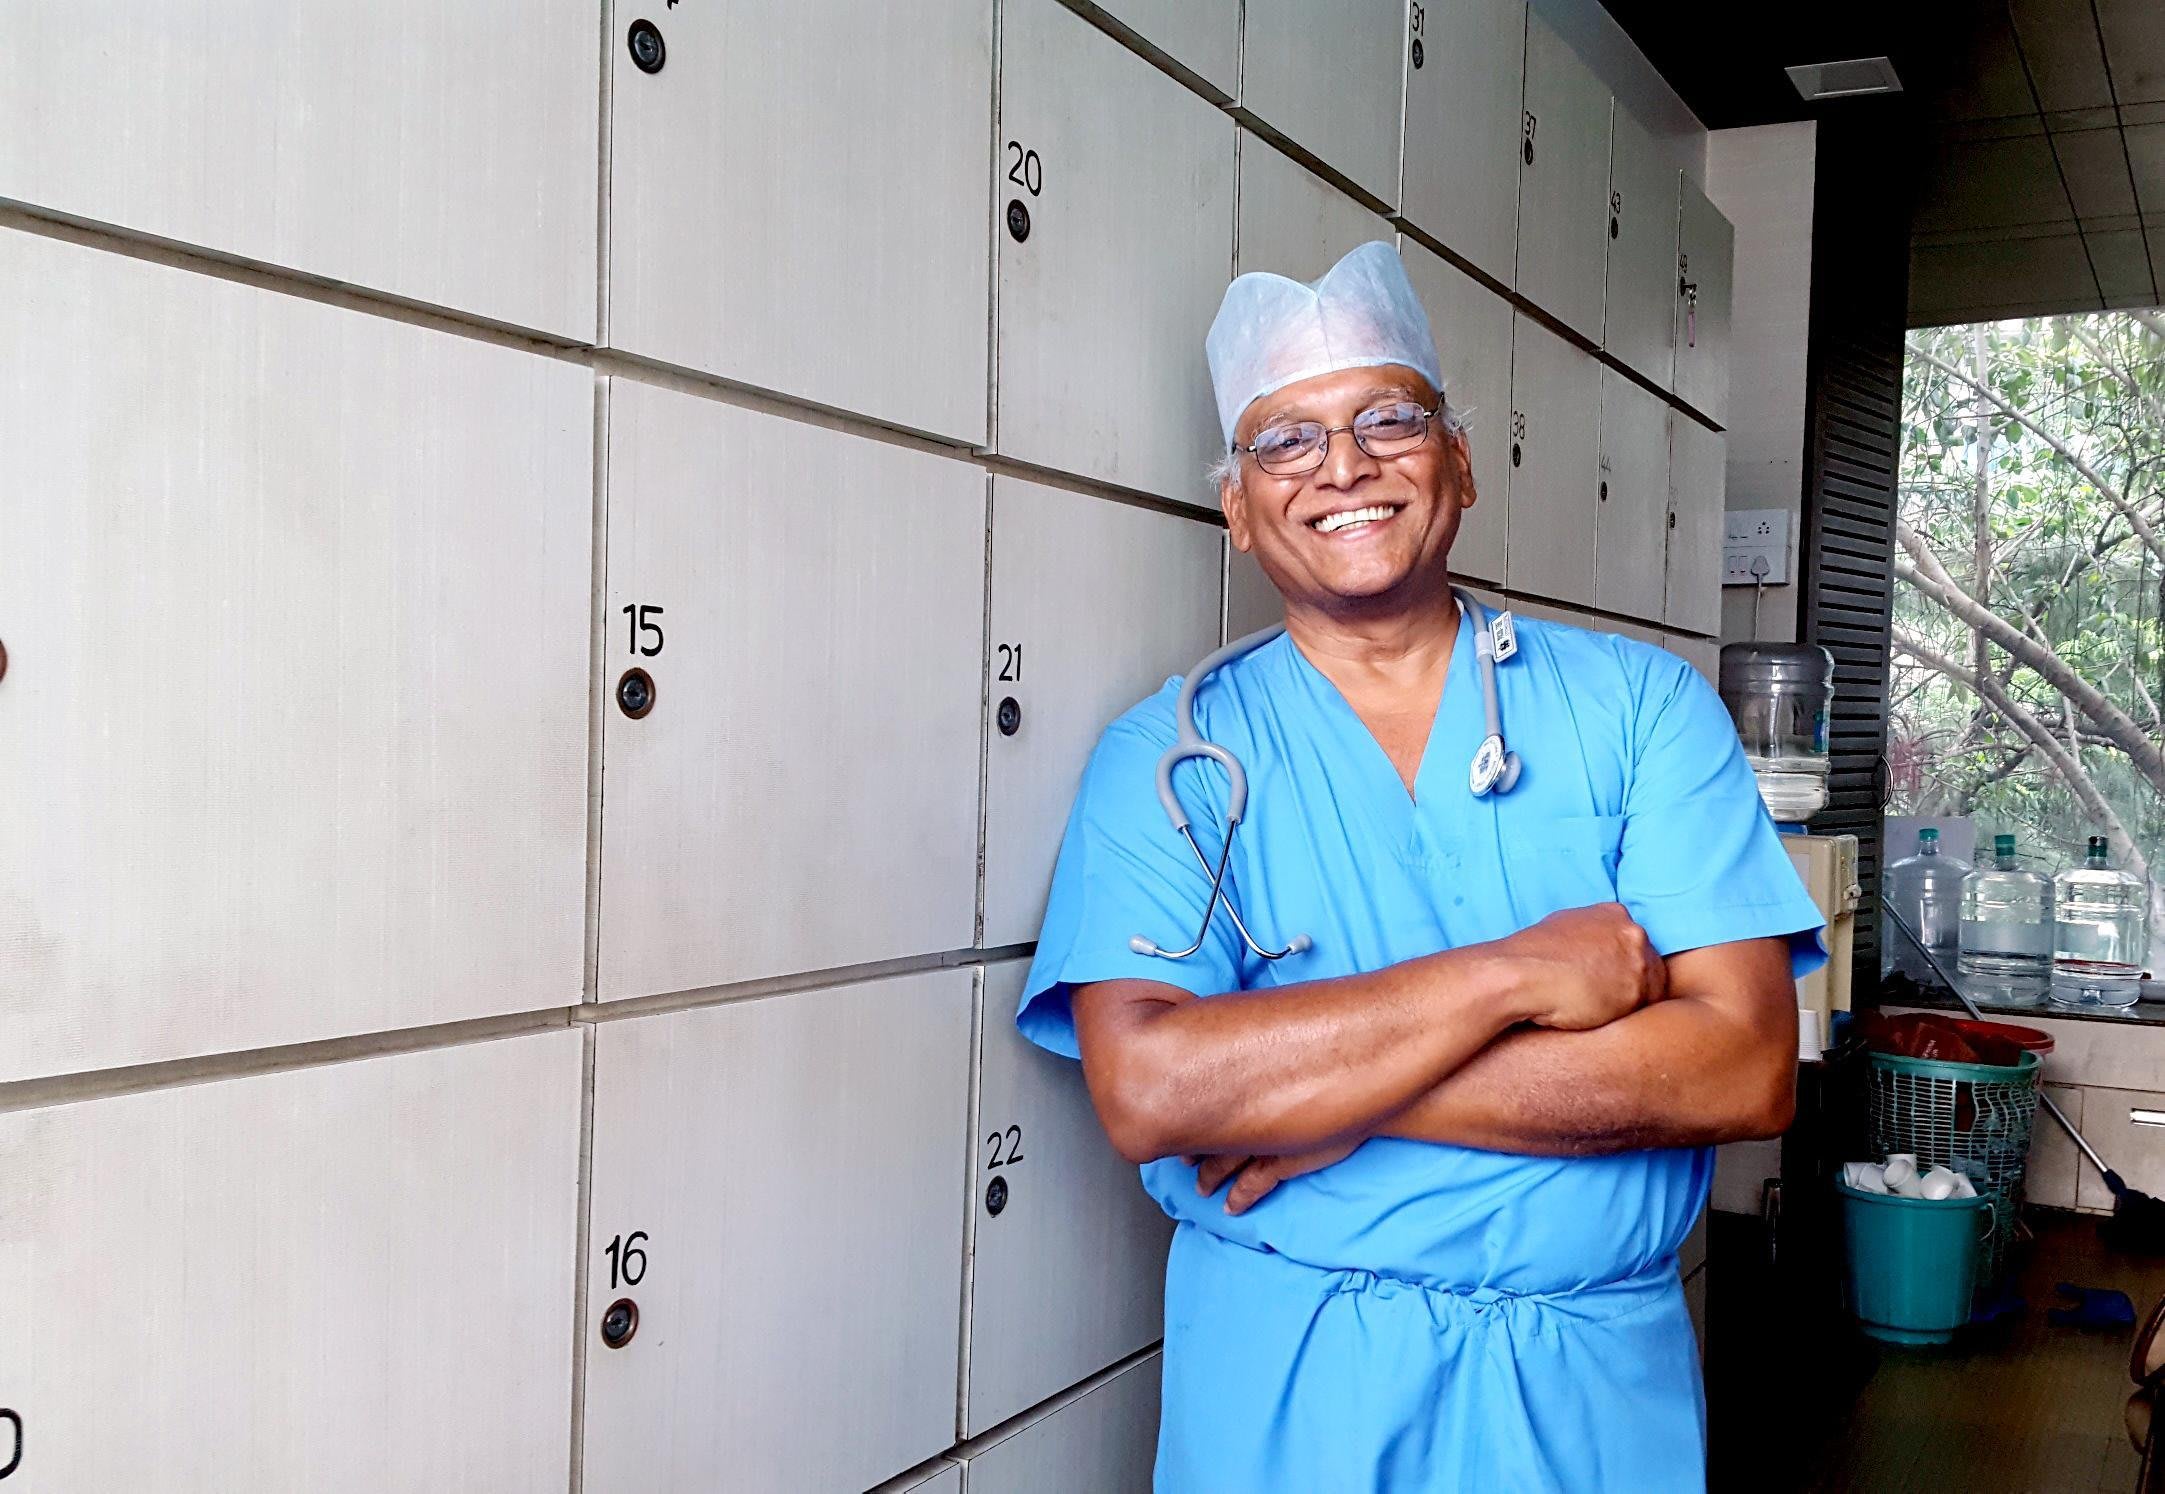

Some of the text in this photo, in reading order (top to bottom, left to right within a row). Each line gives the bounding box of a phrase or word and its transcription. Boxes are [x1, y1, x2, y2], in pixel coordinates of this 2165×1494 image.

[1412, 2, 1425, 37] 31
[1524, 110, 1537, 140] 37
[1007, 140, 1042, 197] 20
[1610, 190, 1621, 214] 43
[1512, 410, 1526, 440] 38
[1600, 454, 1612, 473] 44
[622, 603, 664, 657] 15
[998, 642, 1022, 682] 21
[986, 1124, 1024, 1170] 22
[604, 1230, 649, 1290] 16
